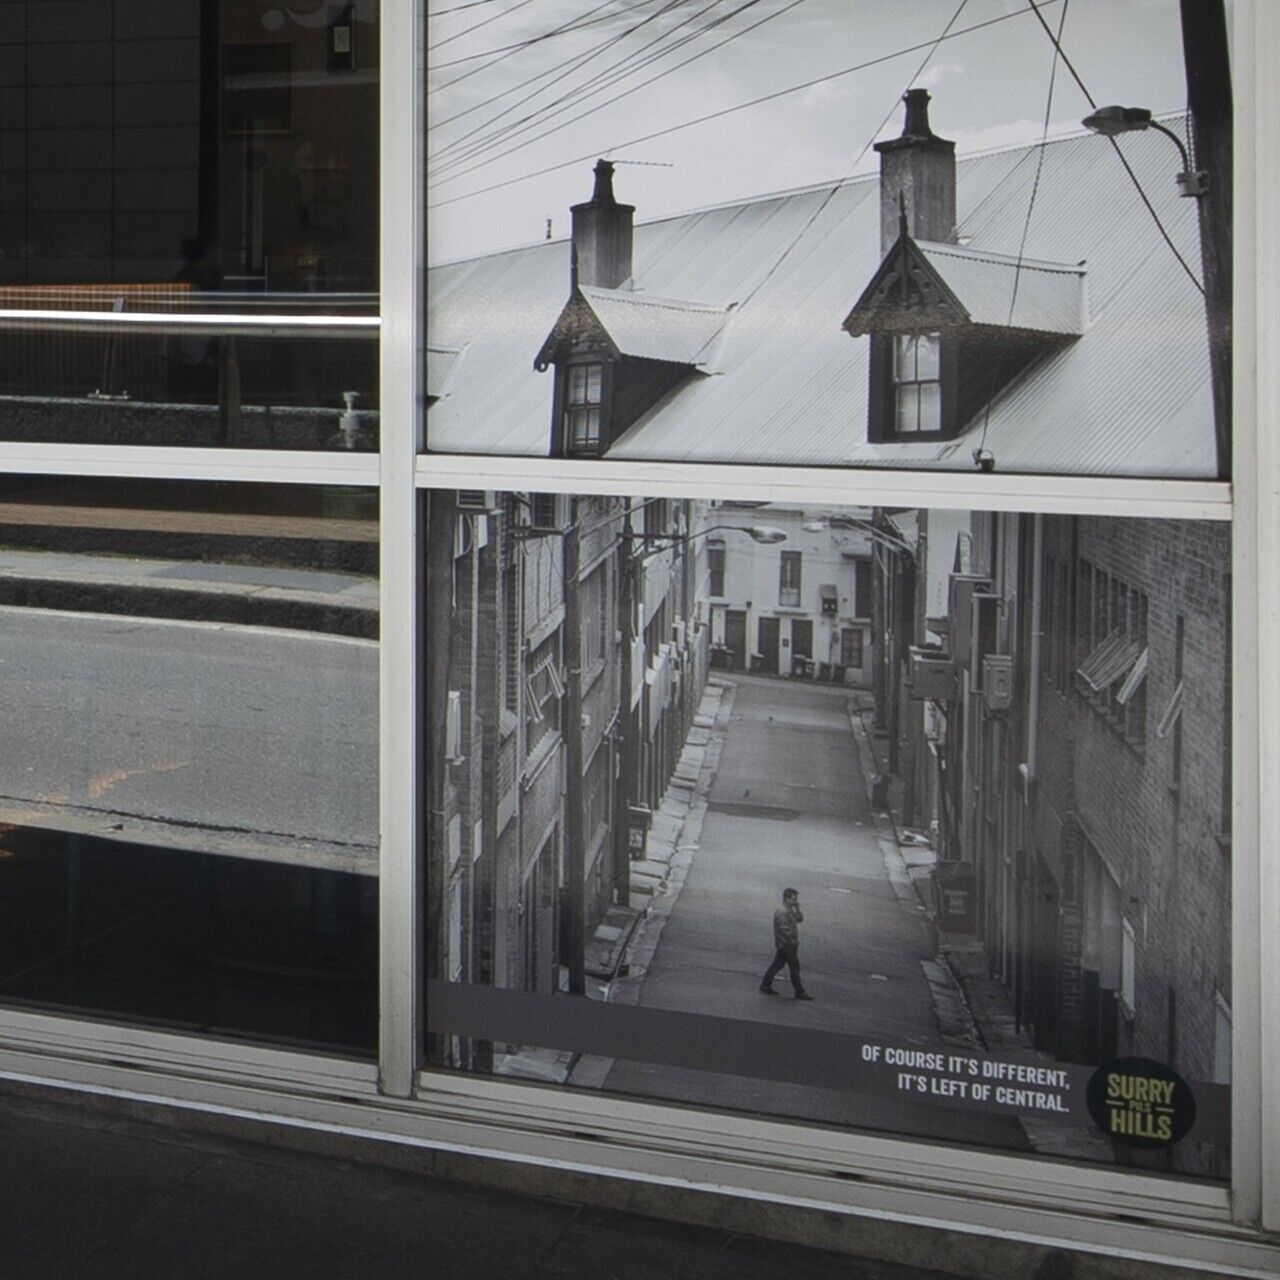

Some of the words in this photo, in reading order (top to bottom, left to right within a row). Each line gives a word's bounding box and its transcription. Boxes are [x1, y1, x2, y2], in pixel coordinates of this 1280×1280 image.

[861, 1045, 881, 1061] OF
[885, 1048, 944, 1071] COURSE
[948, 1056, 978, 1076] IT'S
[982, 1060, 1070, 1090] DIFFERENT,
[898, 1073, 927, 1092] IT'S
[932, 1077, 968, 1097] LEFT
[972, 1083, 992, 1101] OF
[996, 1086, 1070, 1113] CENTRAL.
[1107, 1073, 1175, 1104] SURRY
[1129, 1100, 1152, 1113] PILS
[1110, 1108, 1172, 1140] HILLS
